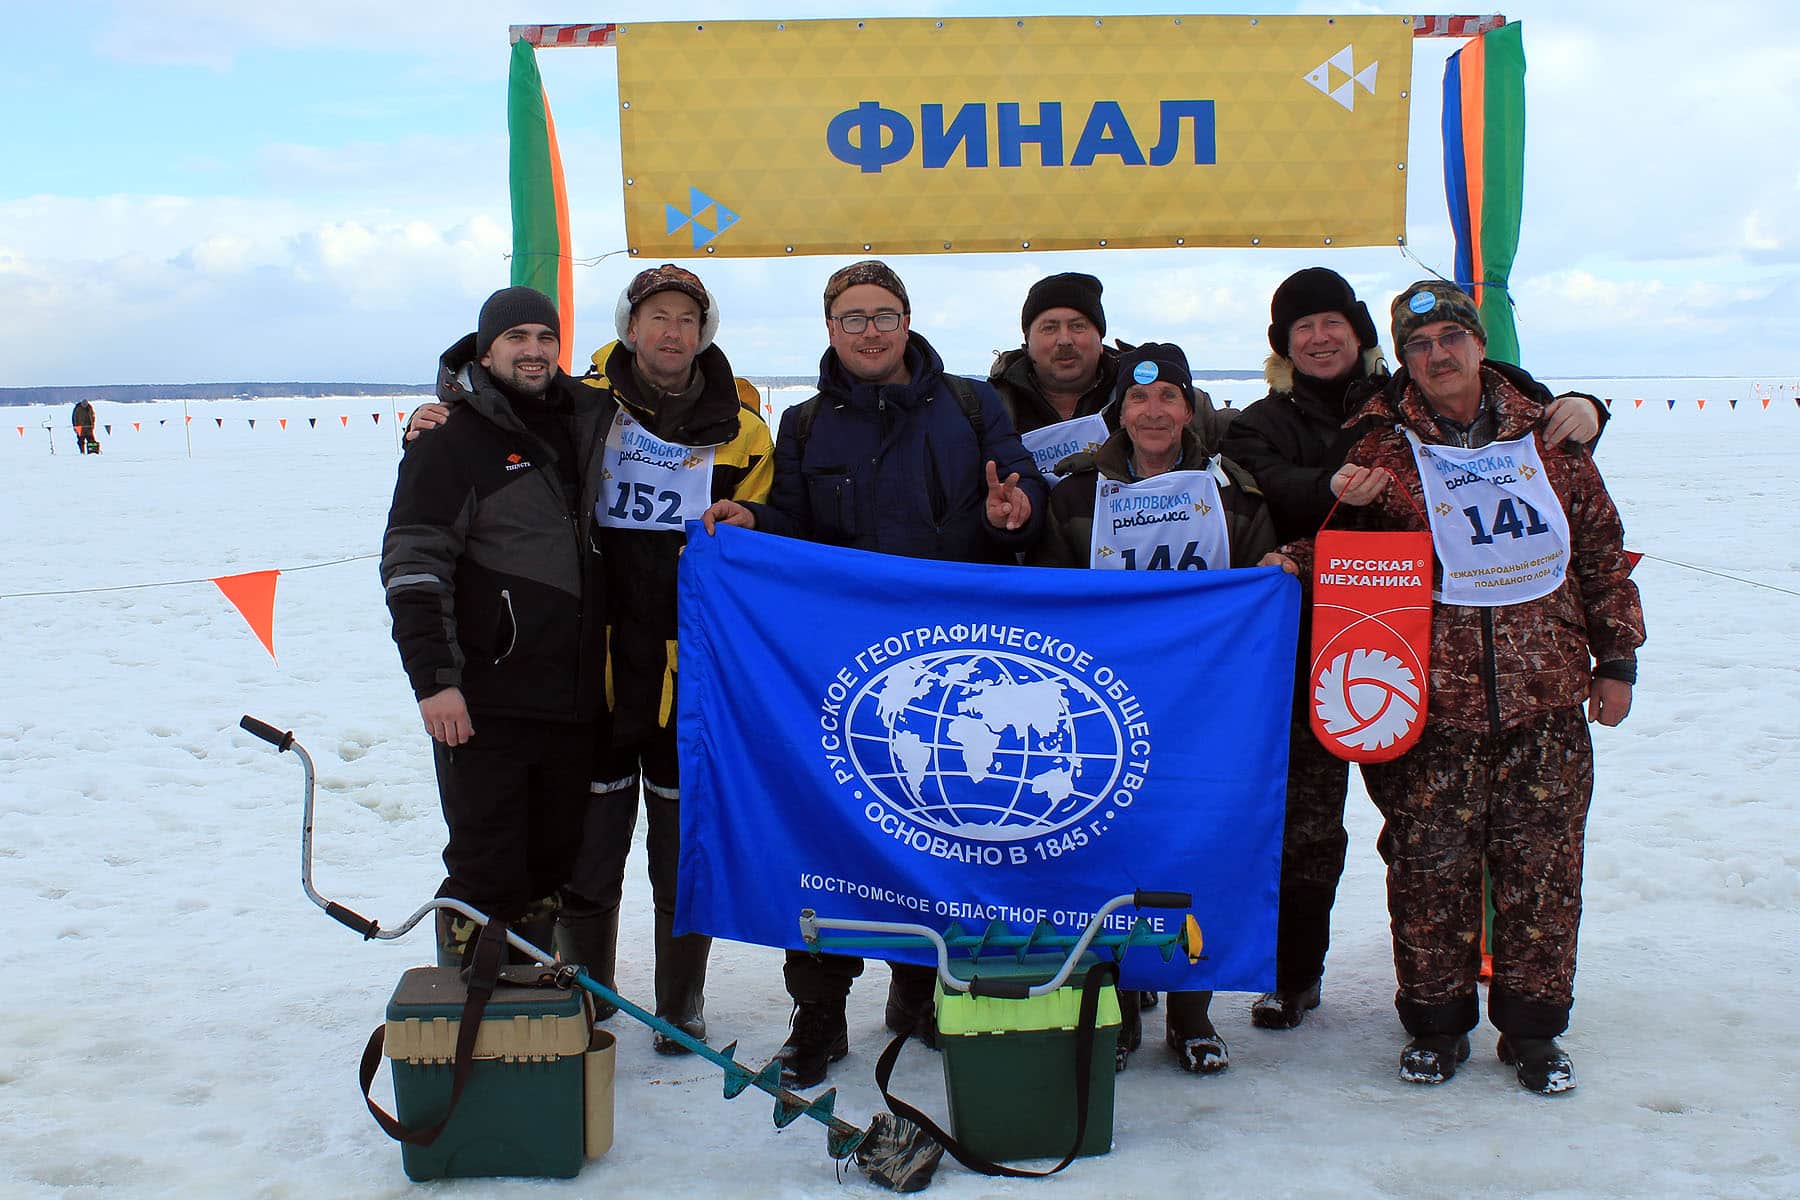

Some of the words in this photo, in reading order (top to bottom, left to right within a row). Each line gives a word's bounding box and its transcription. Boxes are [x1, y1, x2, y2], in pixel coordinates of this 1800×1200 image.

[826, 99, 1217, 174] ФИНАЛ
[607, 481, 683, 525] 152
[1109, 492, 1192, 513] ЧКАЛОВСКАЯ
[1112, 509, 1190, 536] рыбалка
[1462, 497, 1549, 546] 141
[1121, 541, 1209, 571] 146
[1330, 559, 1413, 571] РУССКАЯ
[1320, 573, 1422, 587] МЕХАНИКА
[820, 667, 859, 785] РУССКОЕ
[854, 623, 1094, 673] ГЕОГРАФИЧЕСКОЕ
[1093, 666, 1151, 808] ОБЩЕСТВО
[864, 801, 1003, 865] ОСНОВАНО
[1009, 846, 1029, 865] В
[1034, 830, 1089, 861] 1845
[800, 873, 930, 912] КОСТРОМСКОЕ
[1053, 909, 1165, 932] ОТДЛЕНЕ
